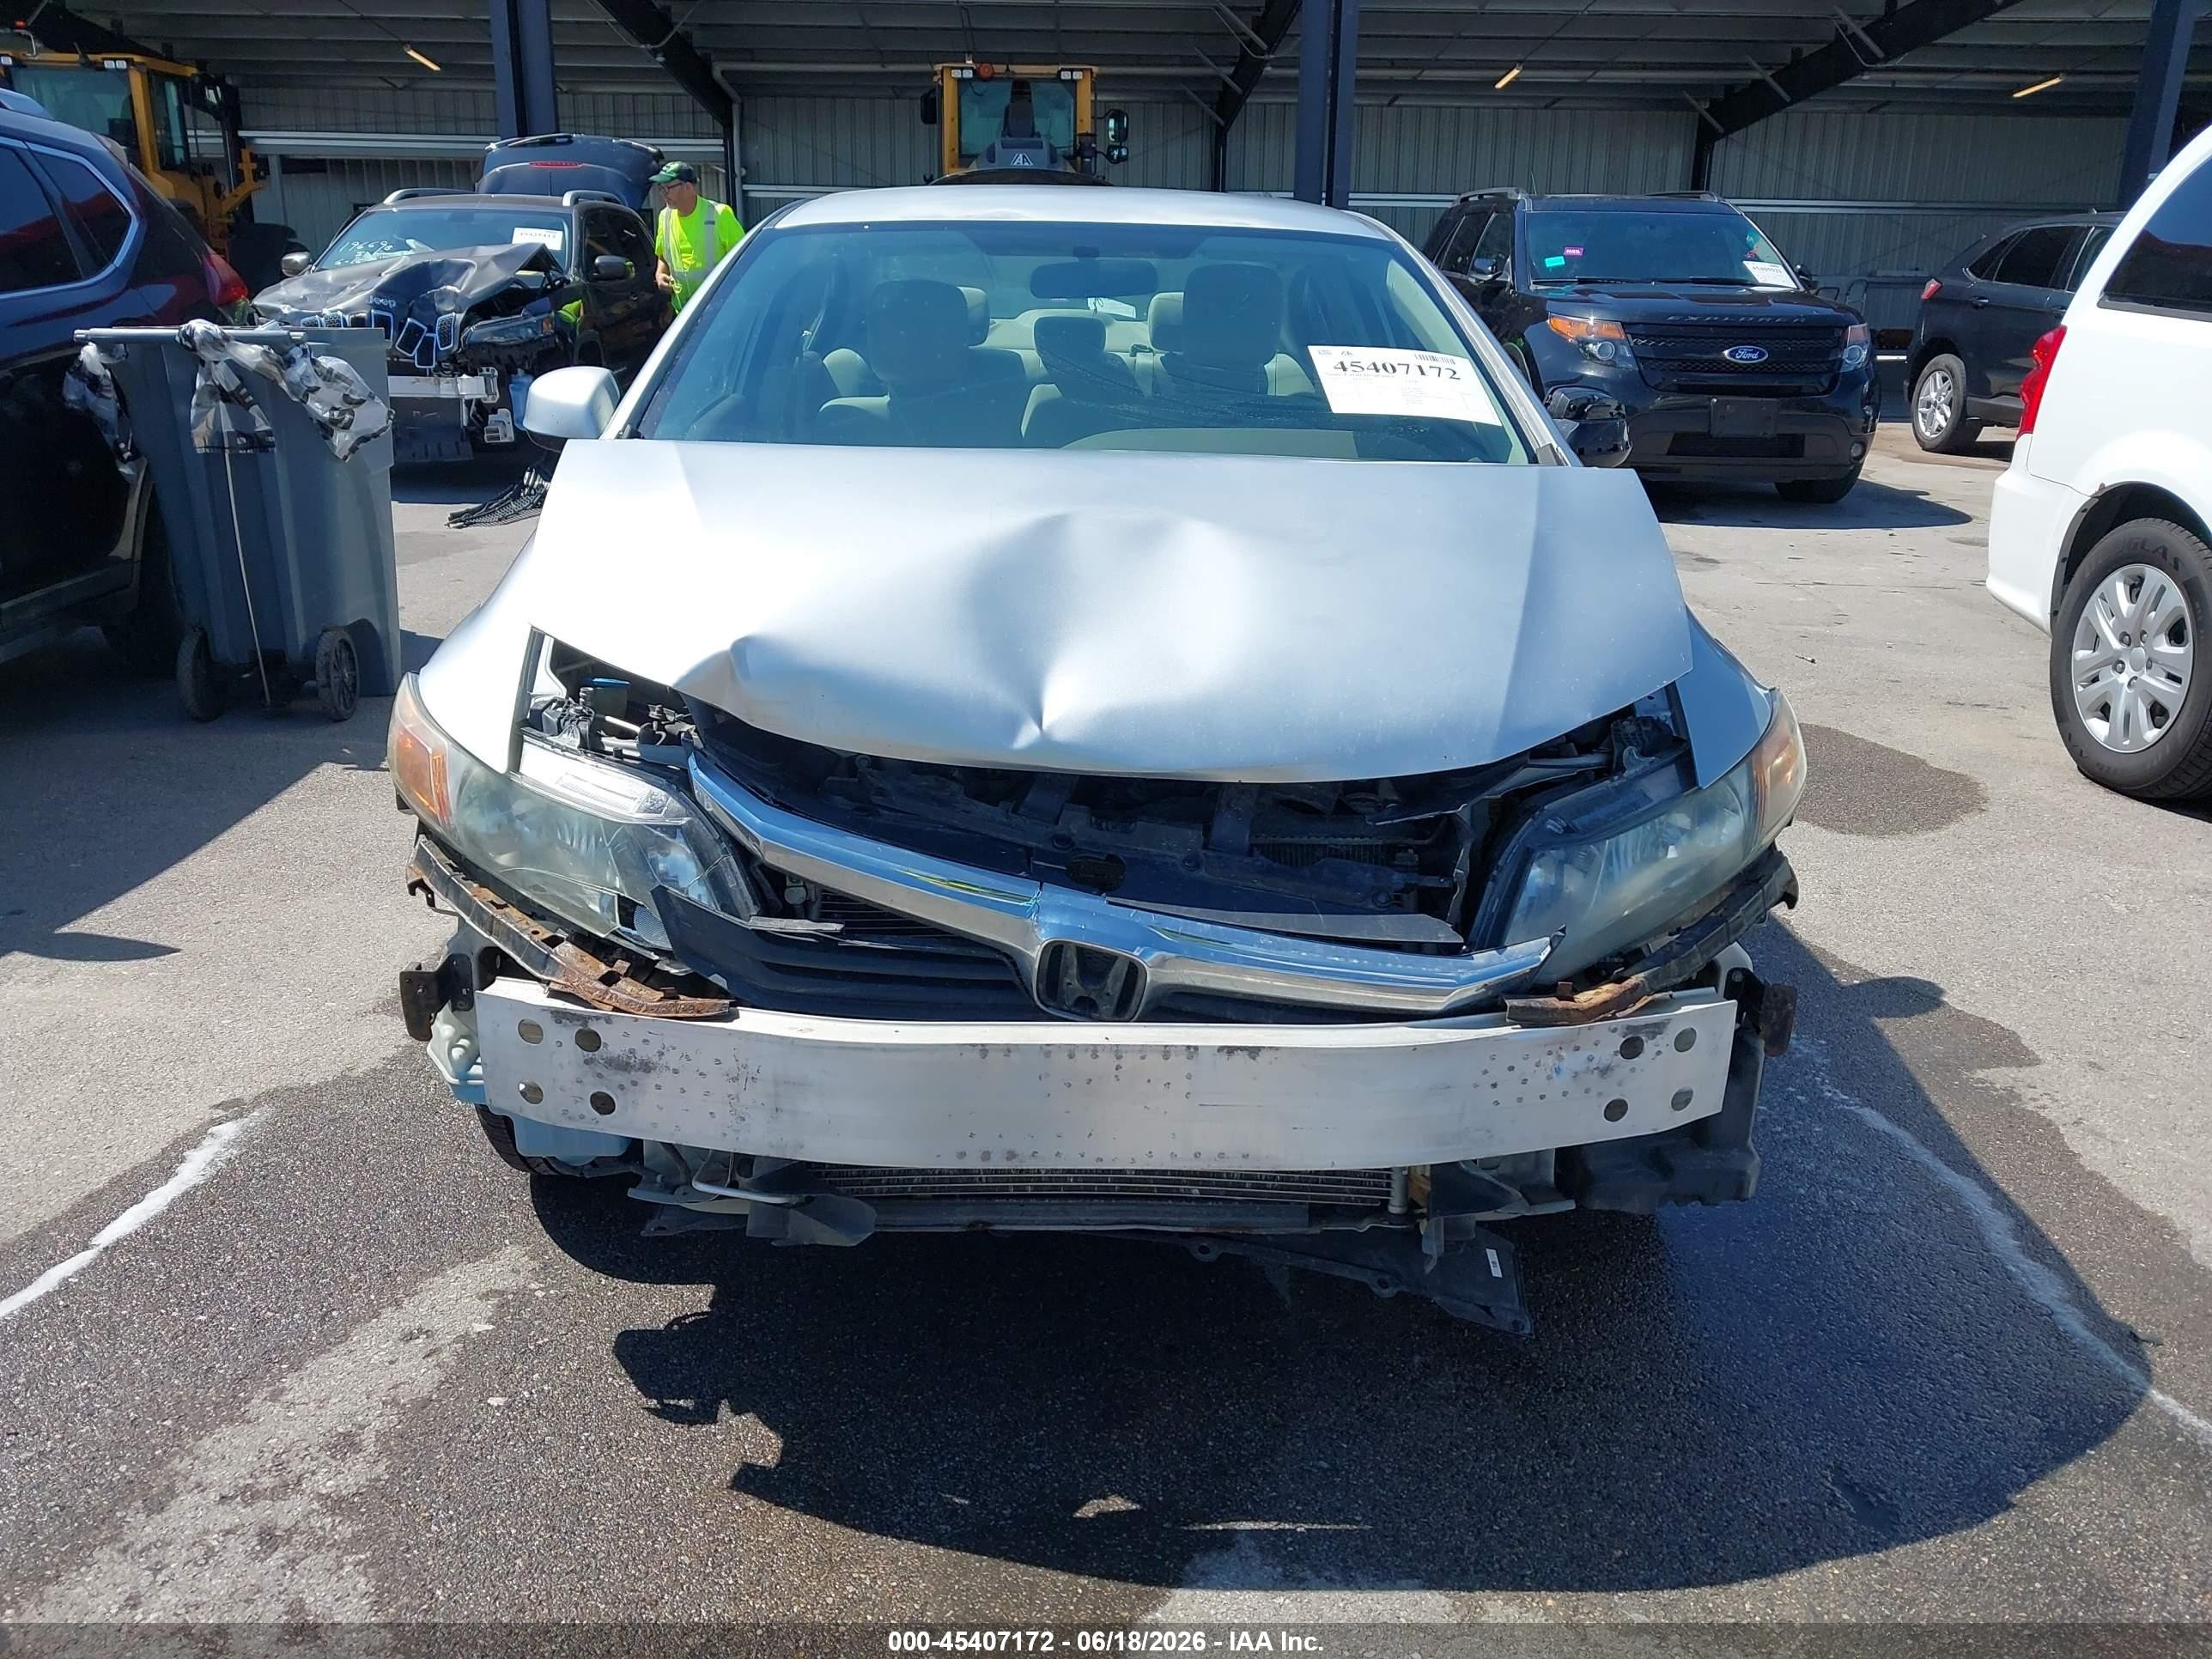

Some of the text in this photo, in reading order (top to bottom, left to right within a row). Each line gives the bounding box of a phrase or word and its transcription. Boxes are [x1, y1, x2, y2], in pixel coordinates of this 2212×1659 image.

[365, 295, 397, 309] Jeep
[1666, 315, 1807, 324] EXPLORER
[1735, 348, 1759, 360] Ford
[1333, 361, 1462, 381] 45407172
